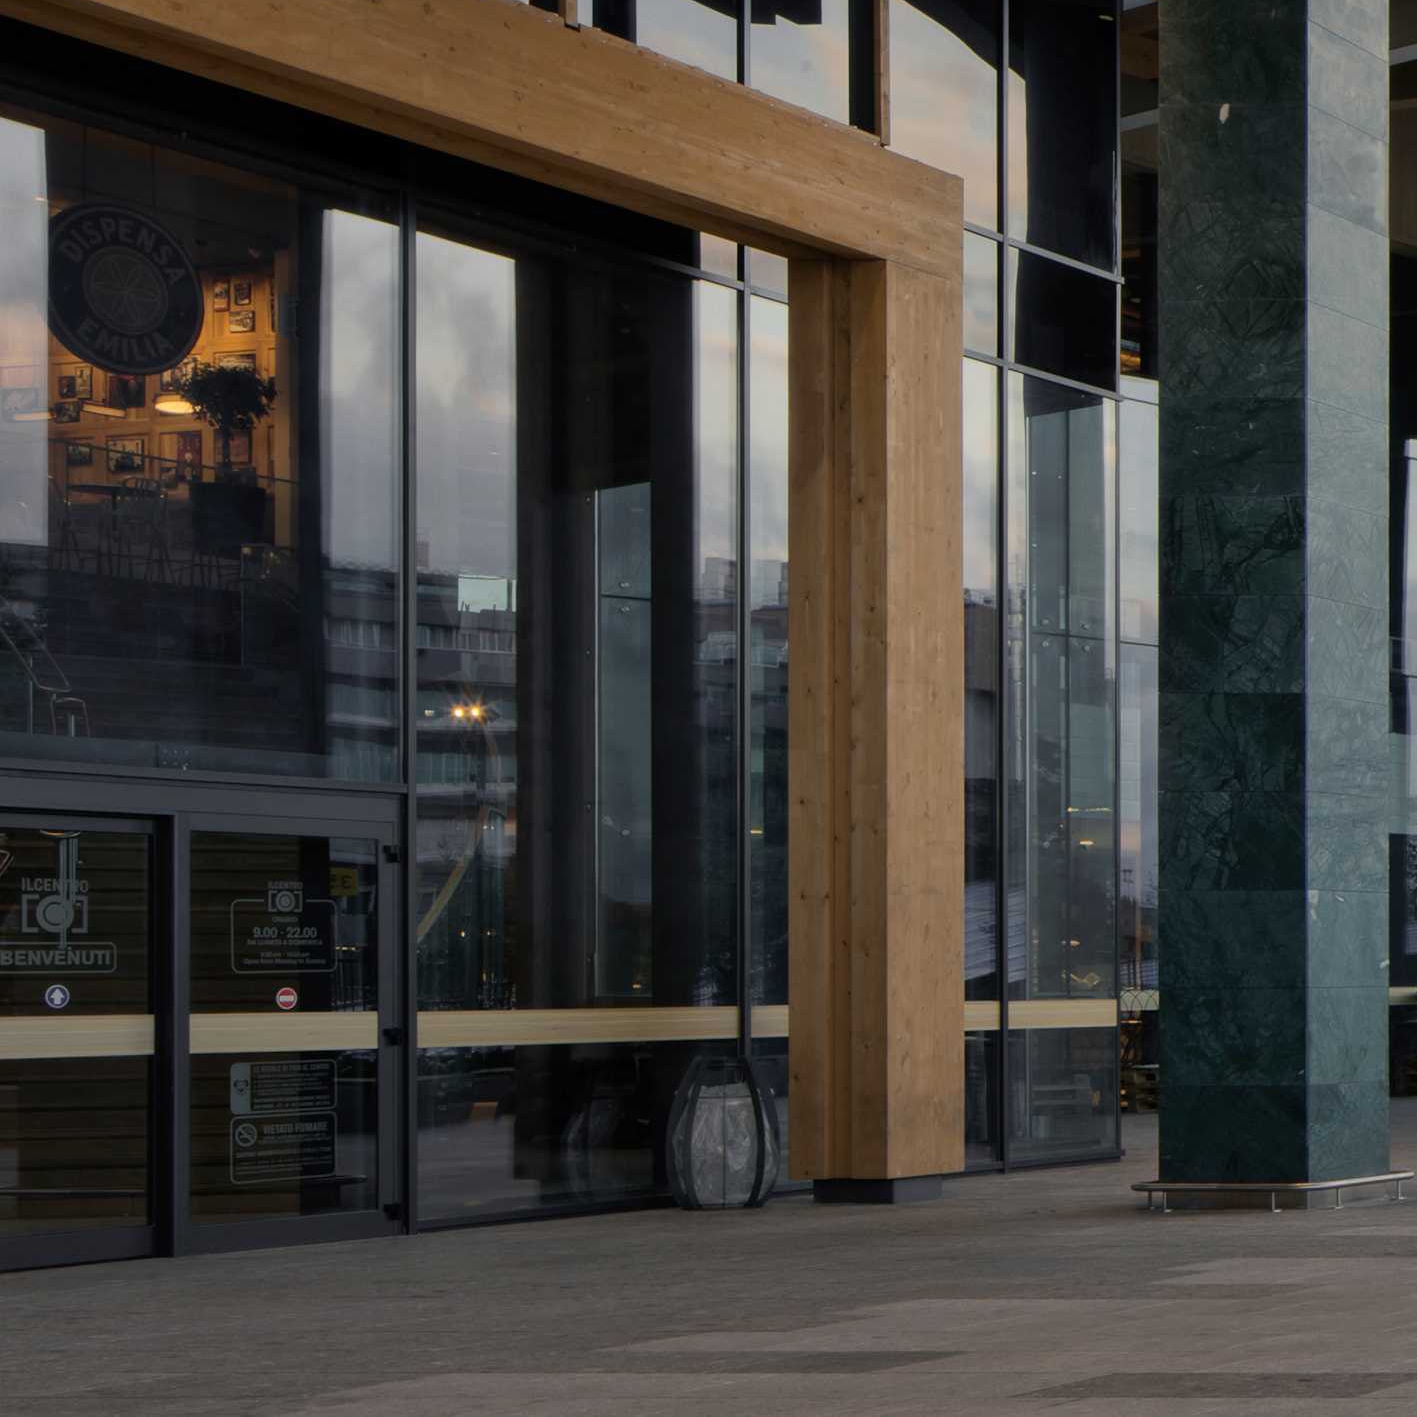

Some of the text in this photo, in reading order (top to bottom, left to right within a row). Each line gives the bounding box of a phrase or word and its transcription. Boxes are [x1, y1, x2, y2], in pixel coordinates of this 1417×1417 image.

[58, 216, 187, 284] DISPENSA
[75, 318, 173, 362] EMILIA
[253, 926, 278, 938] 9.00
[286, 926, 318, 938] 22.00
[0, 949, 111, 966] BENVENUTI
